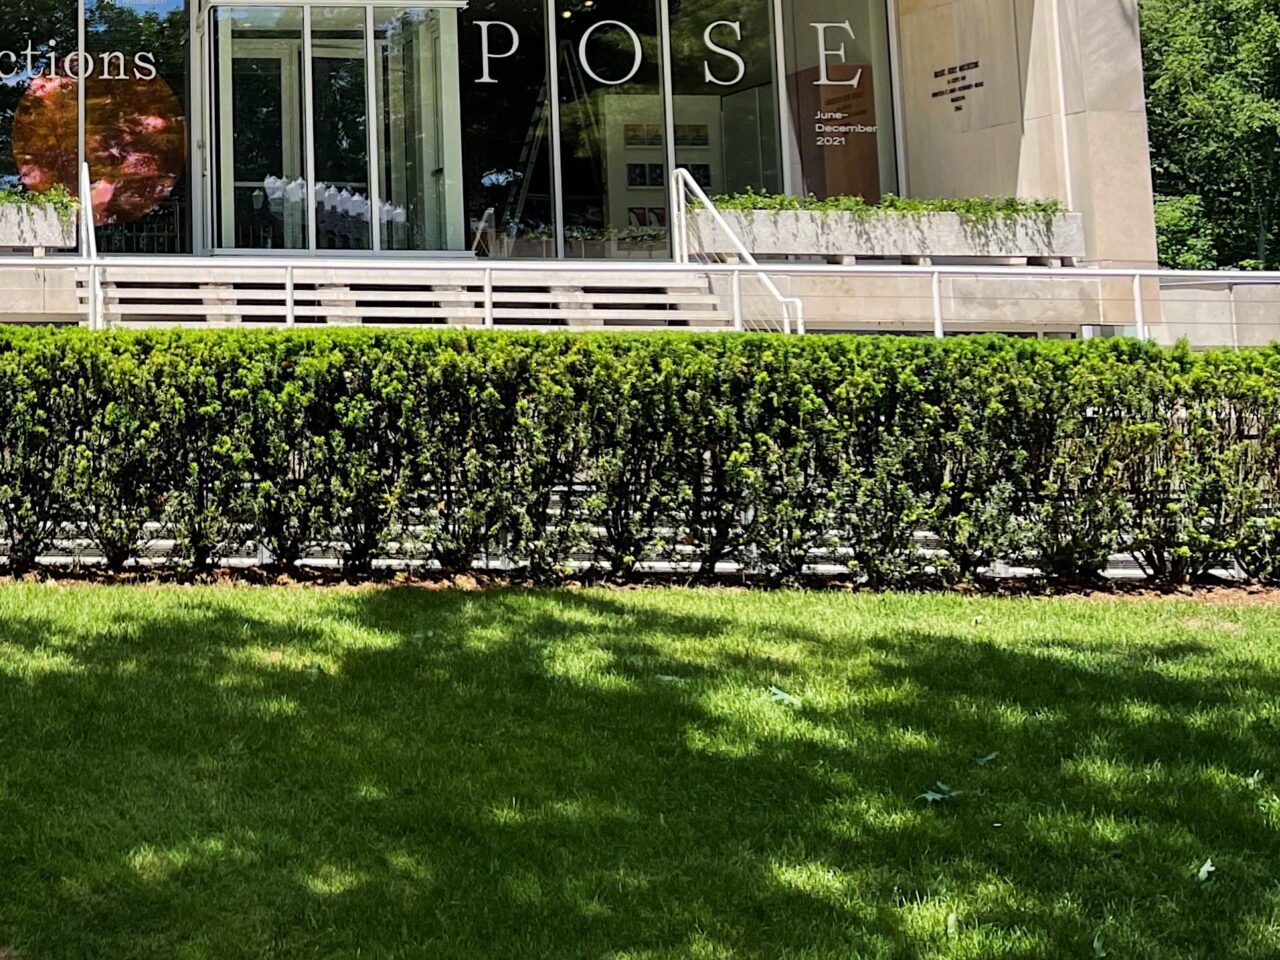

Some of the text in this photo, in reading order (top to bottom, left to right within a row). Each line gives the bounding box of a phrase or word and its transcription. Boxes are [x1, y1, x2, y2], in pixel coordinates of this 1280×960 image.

[472, 19, 862, 88] POSE
[815, 123, 878, 132] December
[816, 137, 846, 145] 2021
